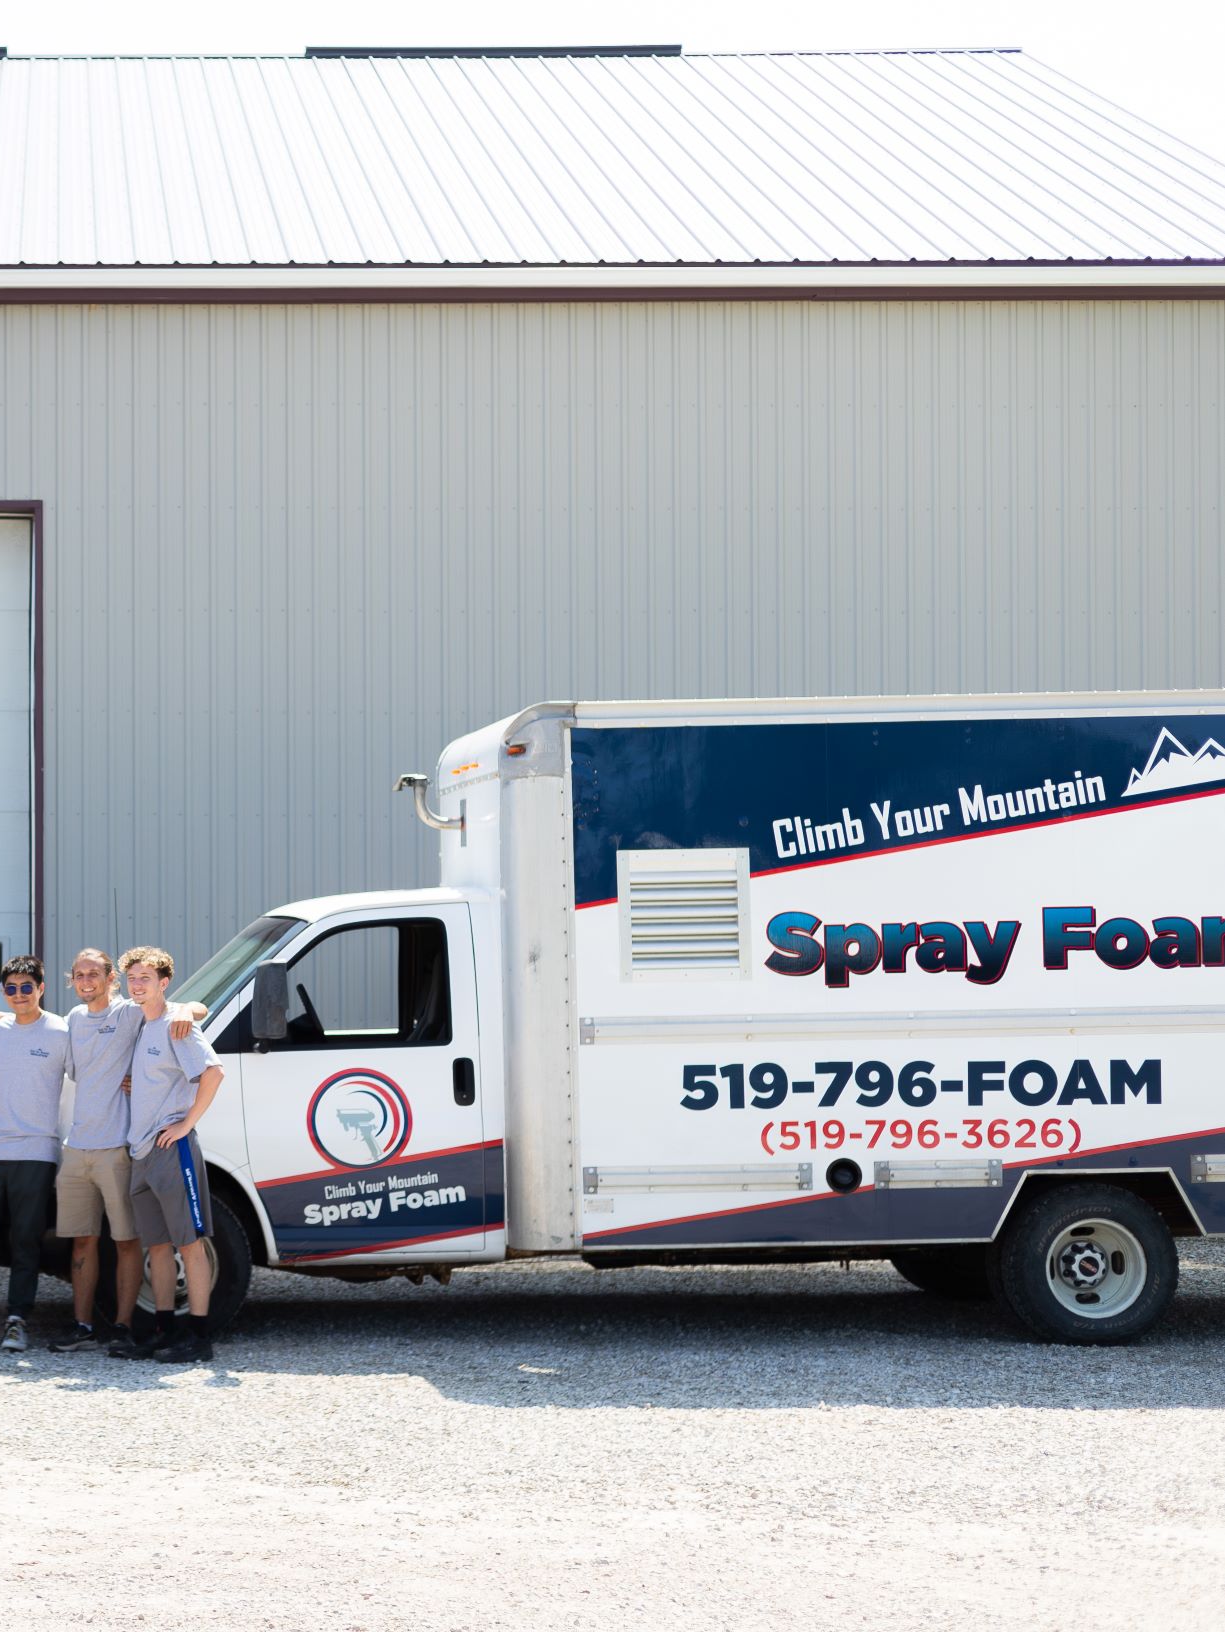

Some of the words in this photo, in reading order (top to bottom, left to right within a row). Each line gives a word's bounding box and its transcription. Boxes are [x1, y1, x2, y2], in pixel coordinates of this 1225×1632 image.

[771, 807, 866, 860] Climb
[869, 799, 951, 841] Your
[957, 770, 1107, 827] Mountain
[763, 910, 1022, 989] Spray
[1041, 905, 1225, 971] Foa
[679, 1058, 1163, 1111] 519-796-FOAM
[760, 1117, 1082, 1157] (519-796-3626)
[303, 1197, 383, 1226] Spray
[388, 1185, 467, 1213] Foam
[324, 1182, 357, 1200] Climb
[358, 1180, 386, 1195] Your
[387, 1171, 439, 1190] Mountain
